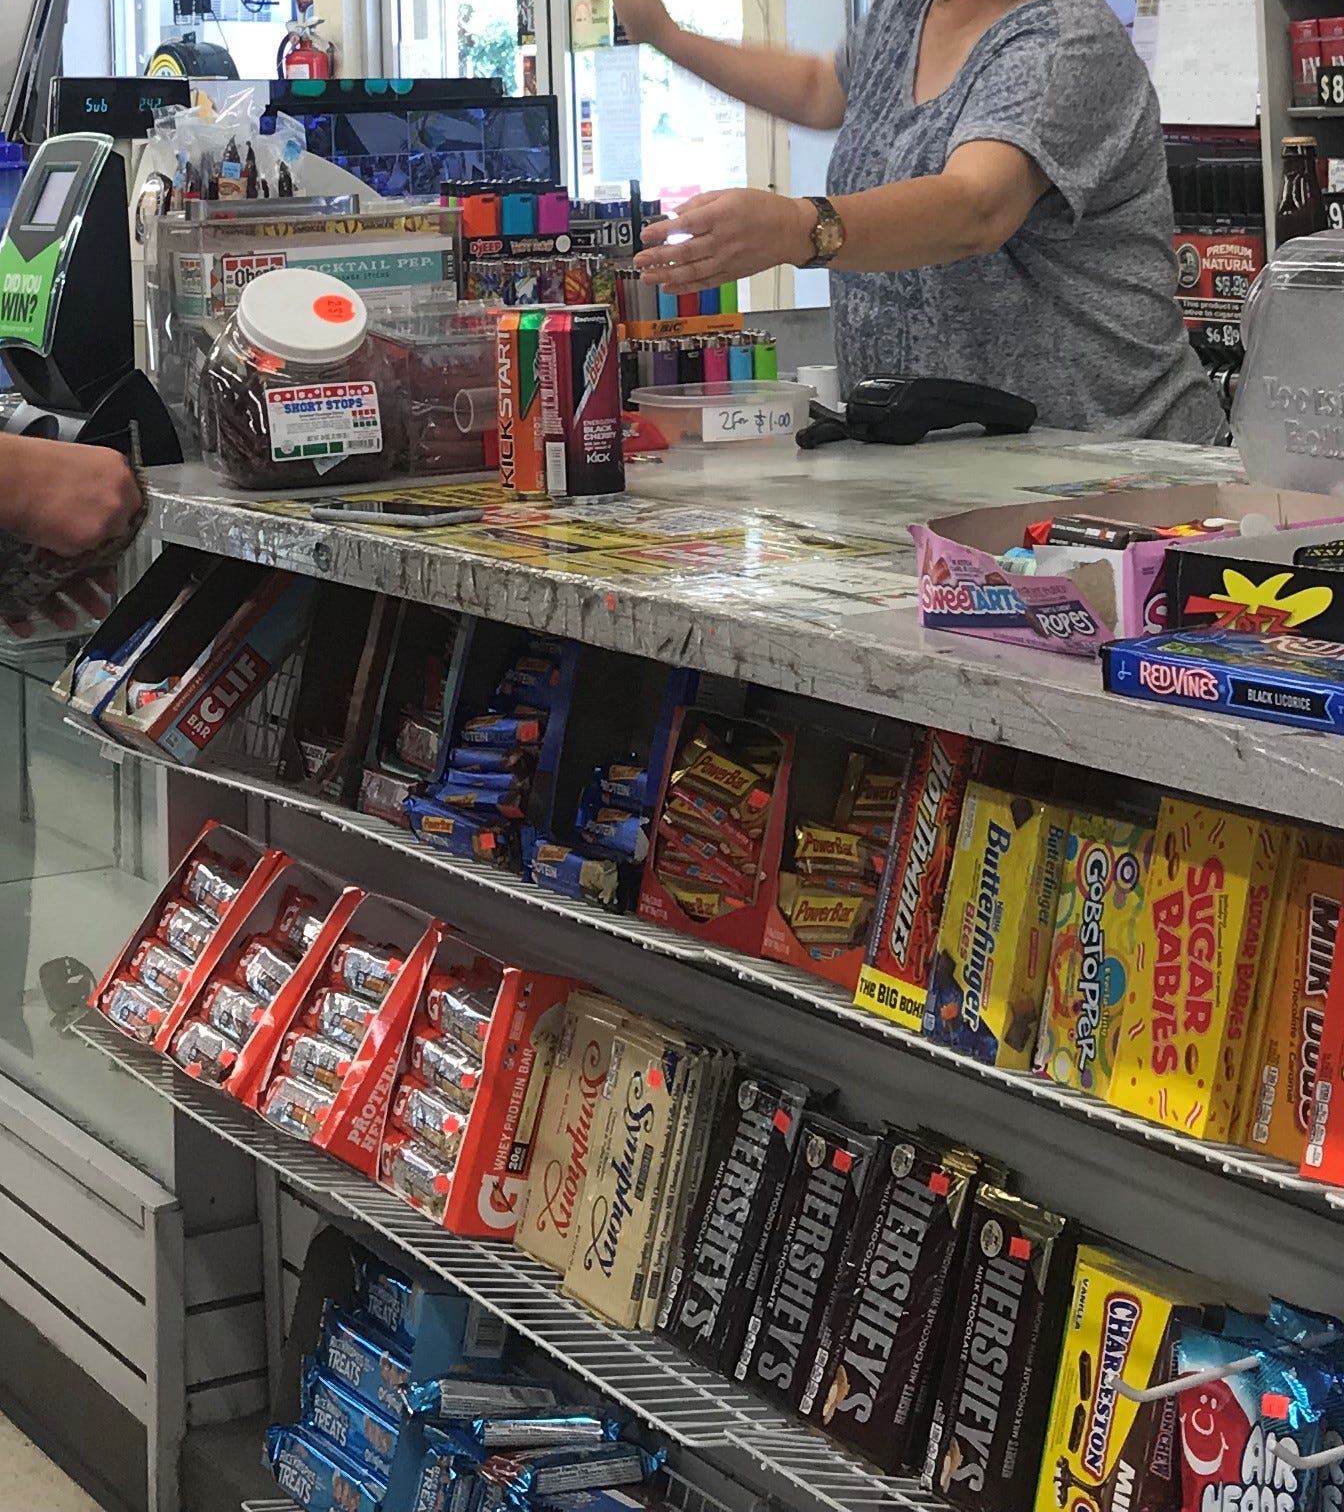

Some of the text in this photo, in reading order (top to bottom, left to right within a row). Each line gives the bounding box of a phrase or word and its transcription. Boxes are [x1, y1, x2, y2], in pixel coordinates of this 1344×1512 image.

[86, 98, 107, 112] Sub
[1202, 258, 1256, 272] NATURAL
[1207, 244, 1252, 258] PREMIUM
[4, 273, 42, 294] DID YOU
[1, 293, 38, 323] WIN?
[284, 398, 363, 414] SHORT STOPS
[498, 330, 516, 490] KICKSTART
[1035, 608, 1093, 638] ROPES
[199, 655, 258, 724] CLIF
[1247, 688, 1273, 707] BLACK
[1274, 693, 1311, 712] LICORICE
[187, 714, 213, 739] BAR
[698, 753, 754, 794] PowerBar
[795, 897, 854, 926] PowerBar
[962, 819, 1011, 1031] Butterfinger
[1183, 856, 1225, 1037] SUGAR
[859, 978, 924, 1019] THE BIG BOX!
[1150, 890, 1184, 1077] BABIES
[494, 1048, 532, 1173] WHEY PROTEIN BAR
[537, 1039, 606, 1239] Symphony
[583, 1070, 654, 1278] Symphony
[680, 1113, 775, 1340] HERSHEY'S
[758, 1167, 848, 1391] HERSHEY'S
[837, 1176, 937, 1425] HERSHEY'S
[327, 1347, 362, 1387] TREATS
[955, 1257, 1027, 1493] HERSHEY'S
[278, 1464, 312, 1505] TREATS
